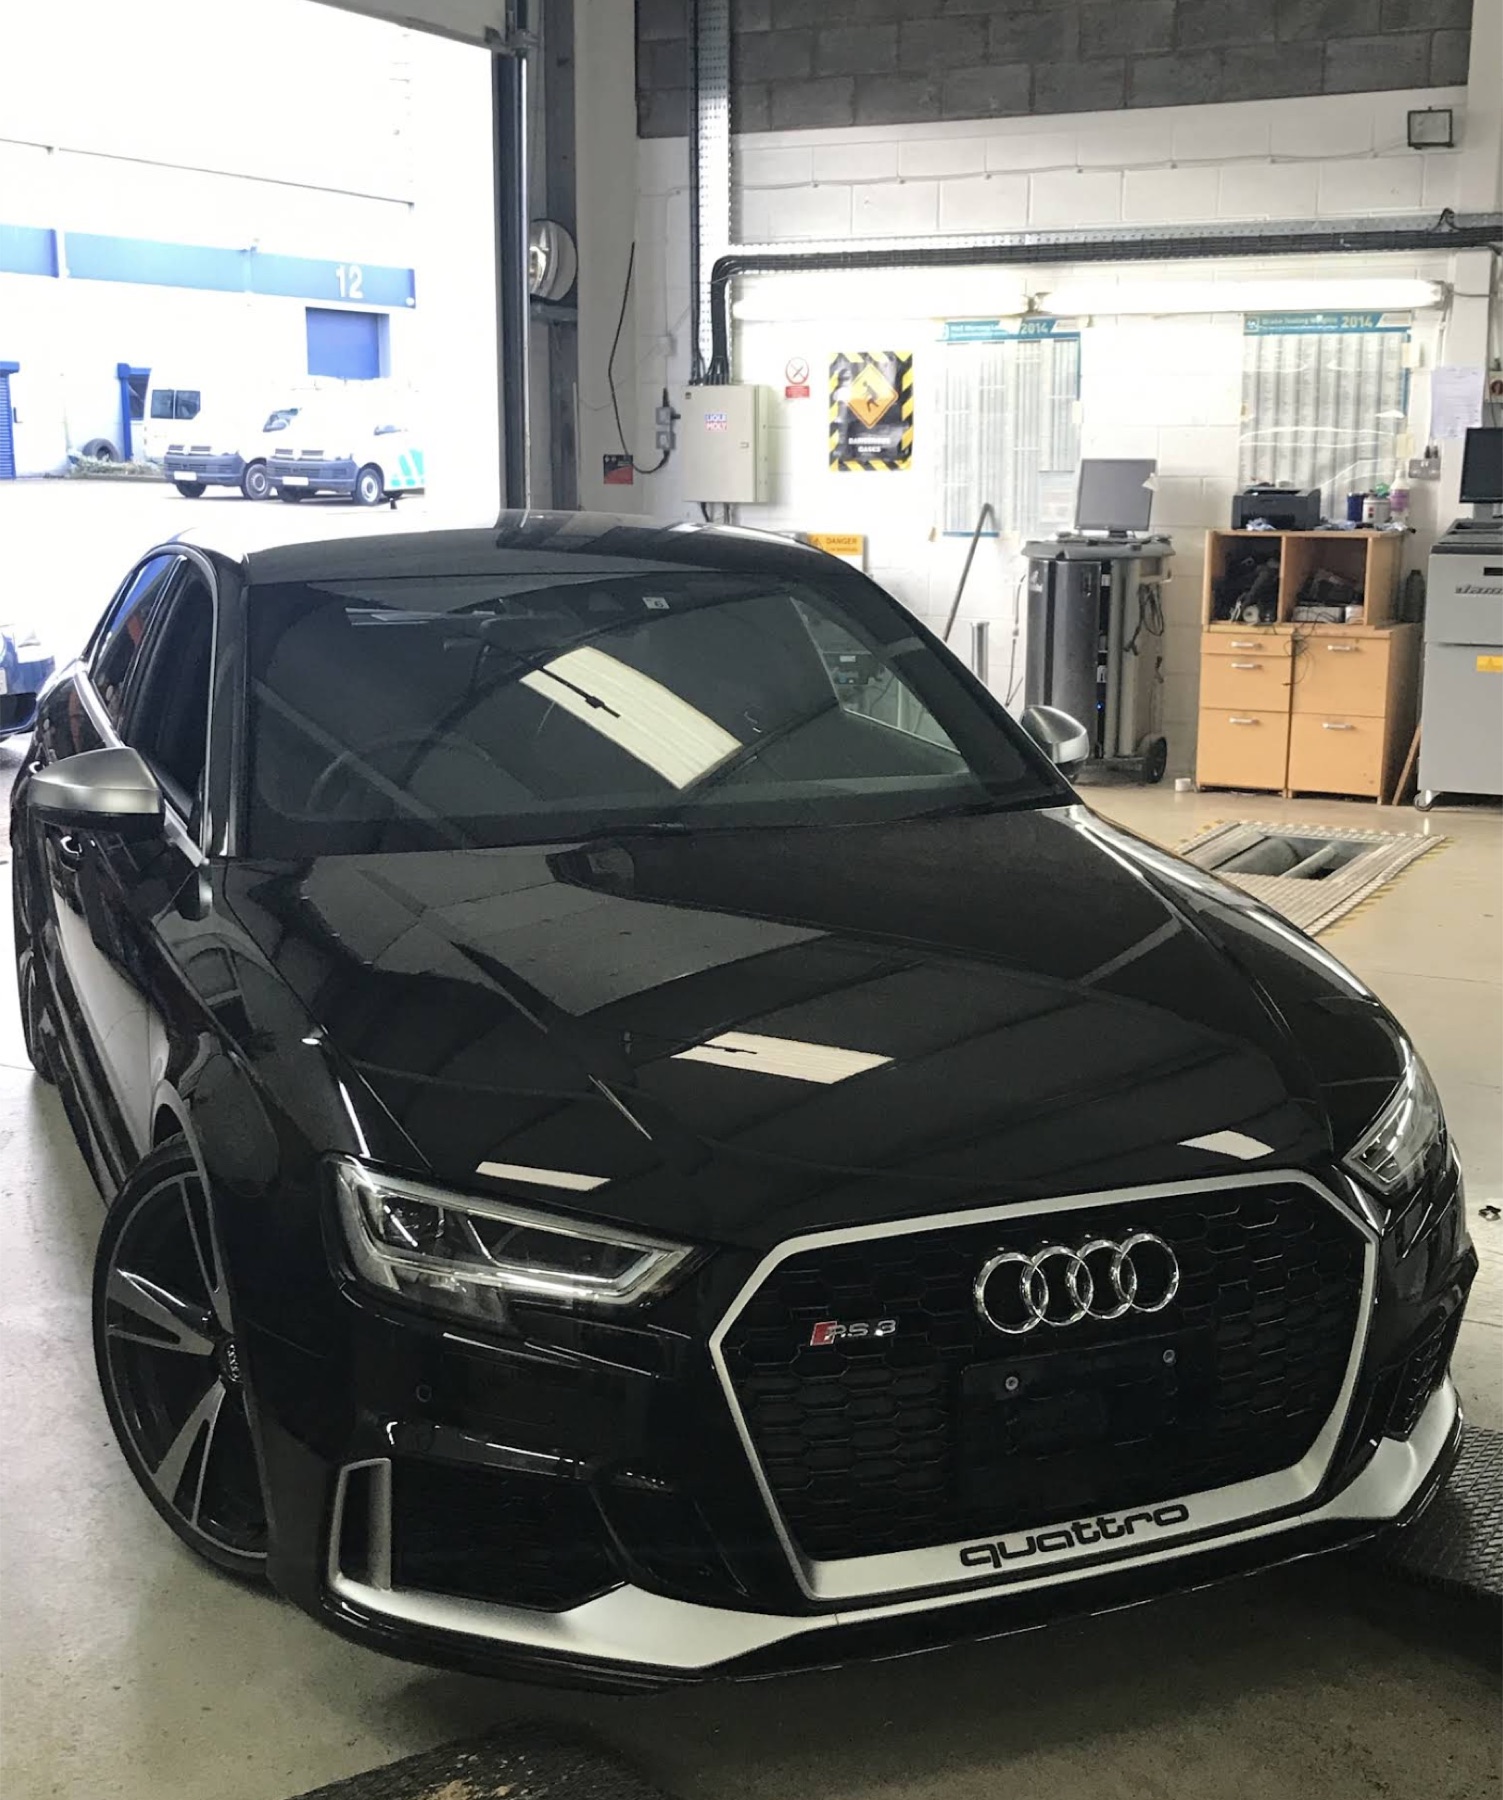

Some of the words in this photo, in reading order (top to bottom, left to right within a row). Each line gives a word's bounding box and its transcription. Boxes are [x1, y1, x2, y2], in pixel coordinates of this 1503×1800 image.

[336, 265, 363, 299] 12
[1341, 314, 1373, 328] 2014
[1020, 322, 1048, 335] 2014
[826, 537, 857, 545] DANGER
[959, 1503, 1190, 1569] quattro
